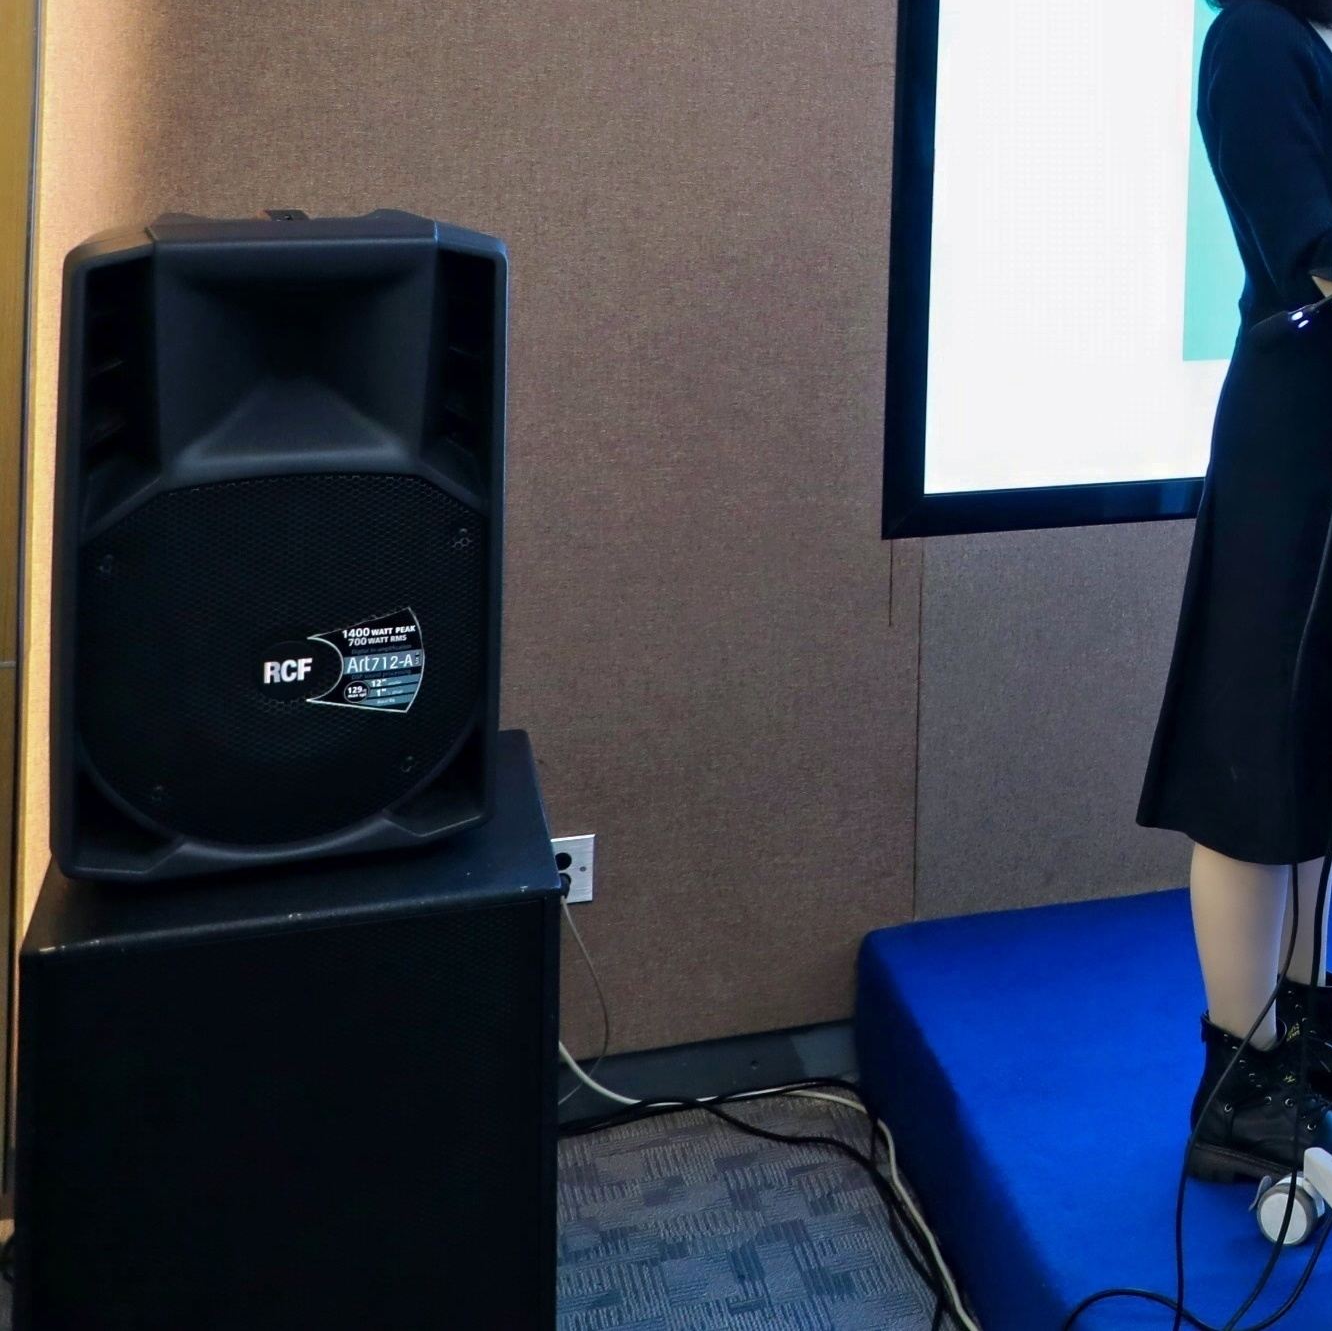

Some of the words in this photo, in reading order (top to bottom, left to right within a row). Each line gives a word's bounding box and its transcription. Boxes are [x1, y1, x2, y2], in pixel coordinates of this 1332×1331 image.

[342, 627, 371, 639] 1400
[371, 626, 393, 636] WATT
[395, 625, 416, 634] PEAK
[348, 637, 367, 647] 700
[368, 636, 389, 645] WATT
[390, 634, 407, 643] RMS
[263, 657, 313, 684] RCF
[347, 653, 413, 674] Art712-A
